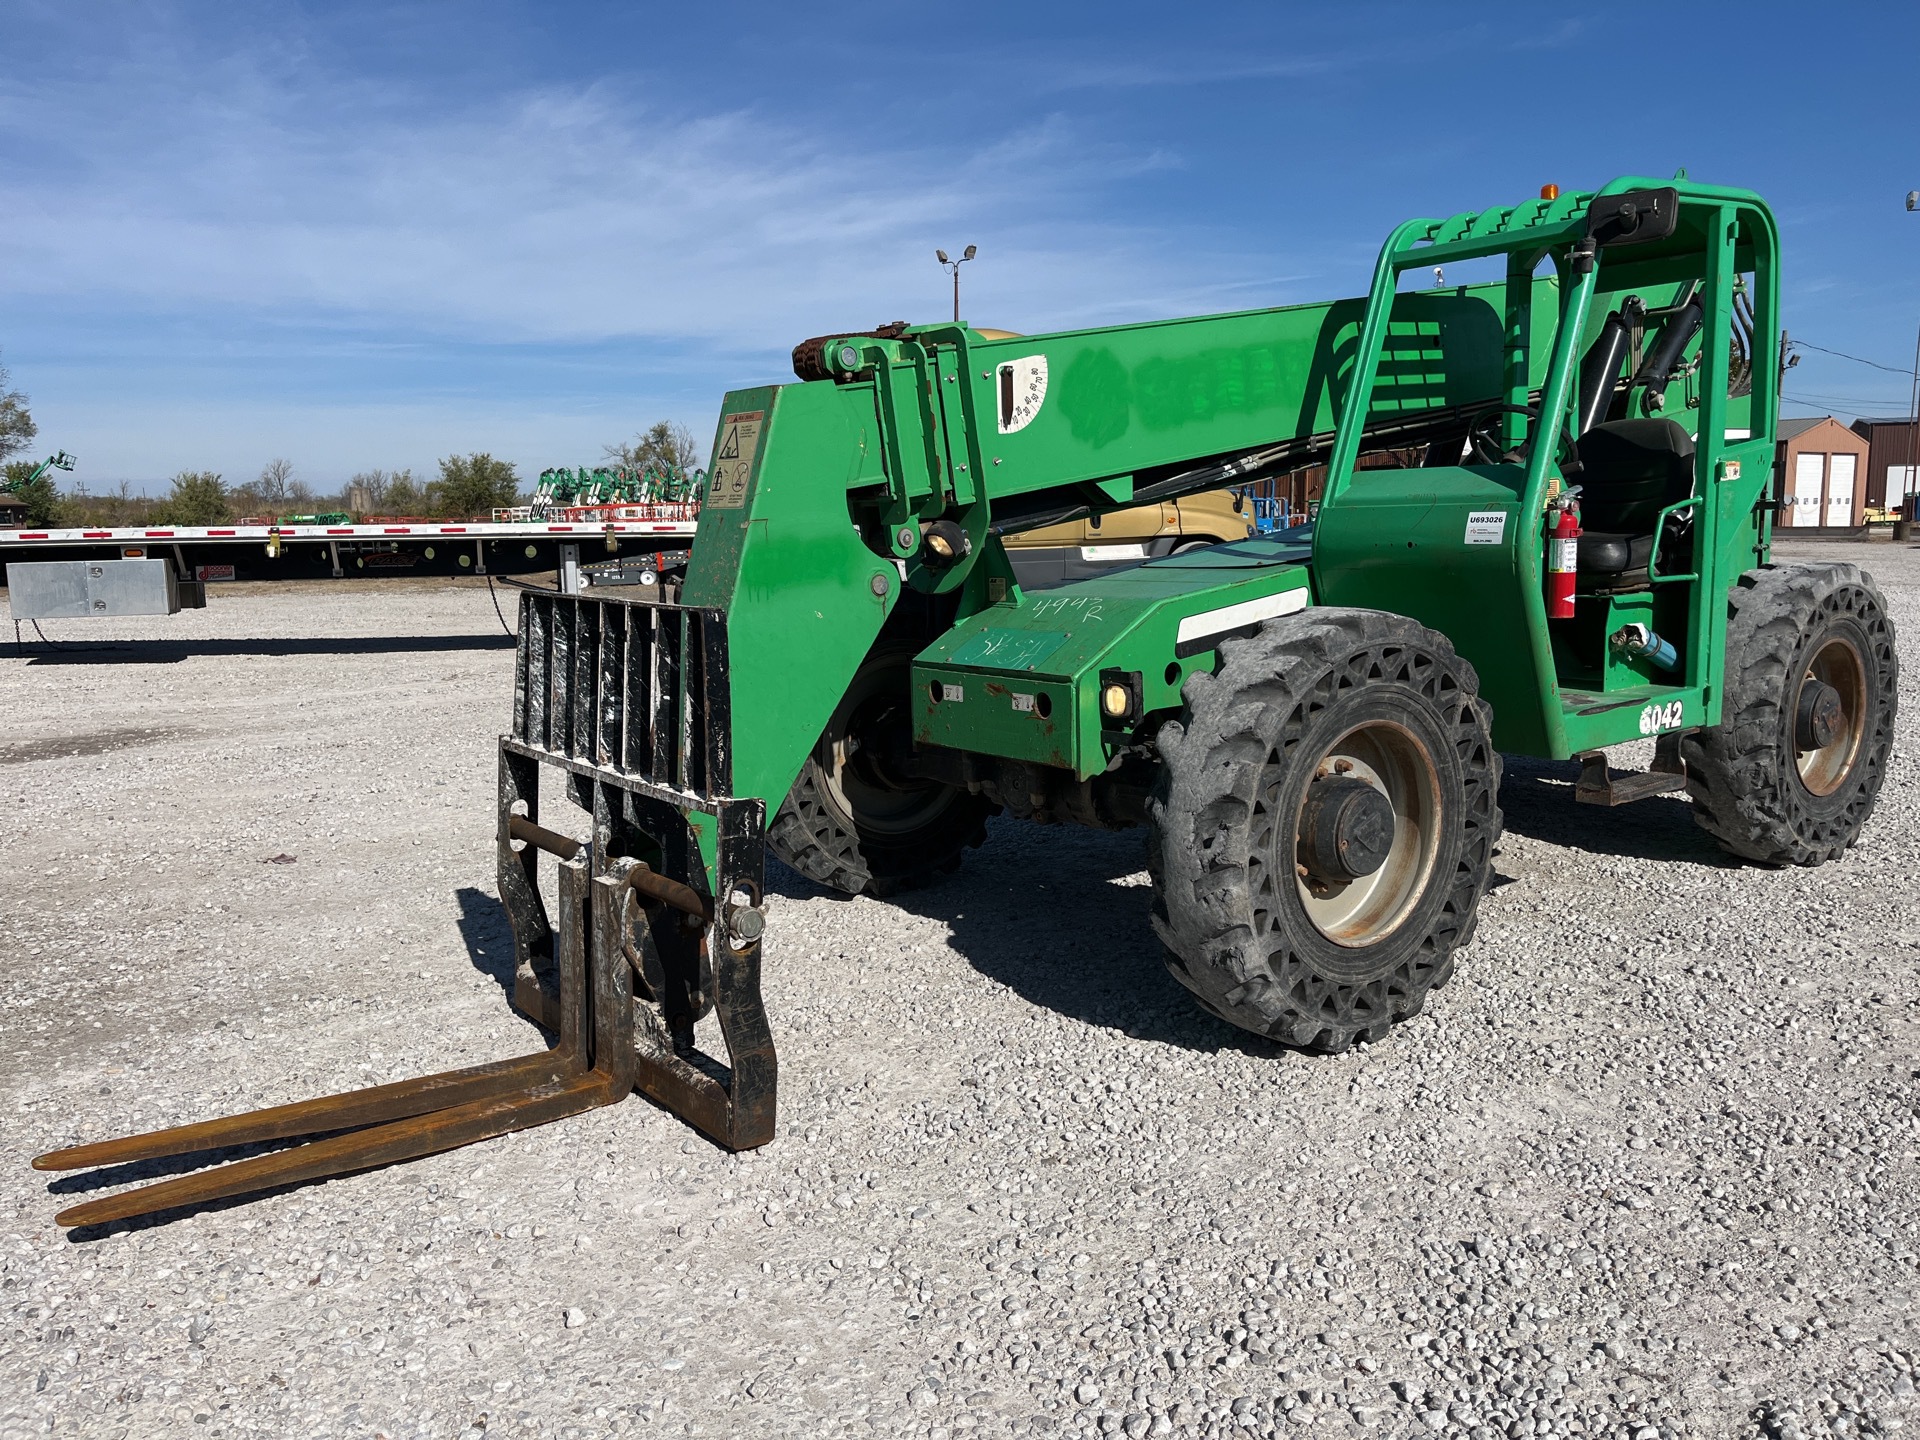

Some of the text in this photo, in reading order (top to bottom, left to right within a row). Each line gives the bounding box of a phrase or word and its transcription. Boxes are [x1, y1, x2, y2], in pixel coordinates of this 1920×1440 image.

[1030, 383, 1037, 391] 60
[1025, 396, 1032, 404] 40
[1031, 393, 1039, 402] 50
[1016, 406, 1022, 416] 20
[1023, 406, 1030, 416] 30
[1082, 605, 1102, 622] R
[1639, 699, 1683, 734] 6042
